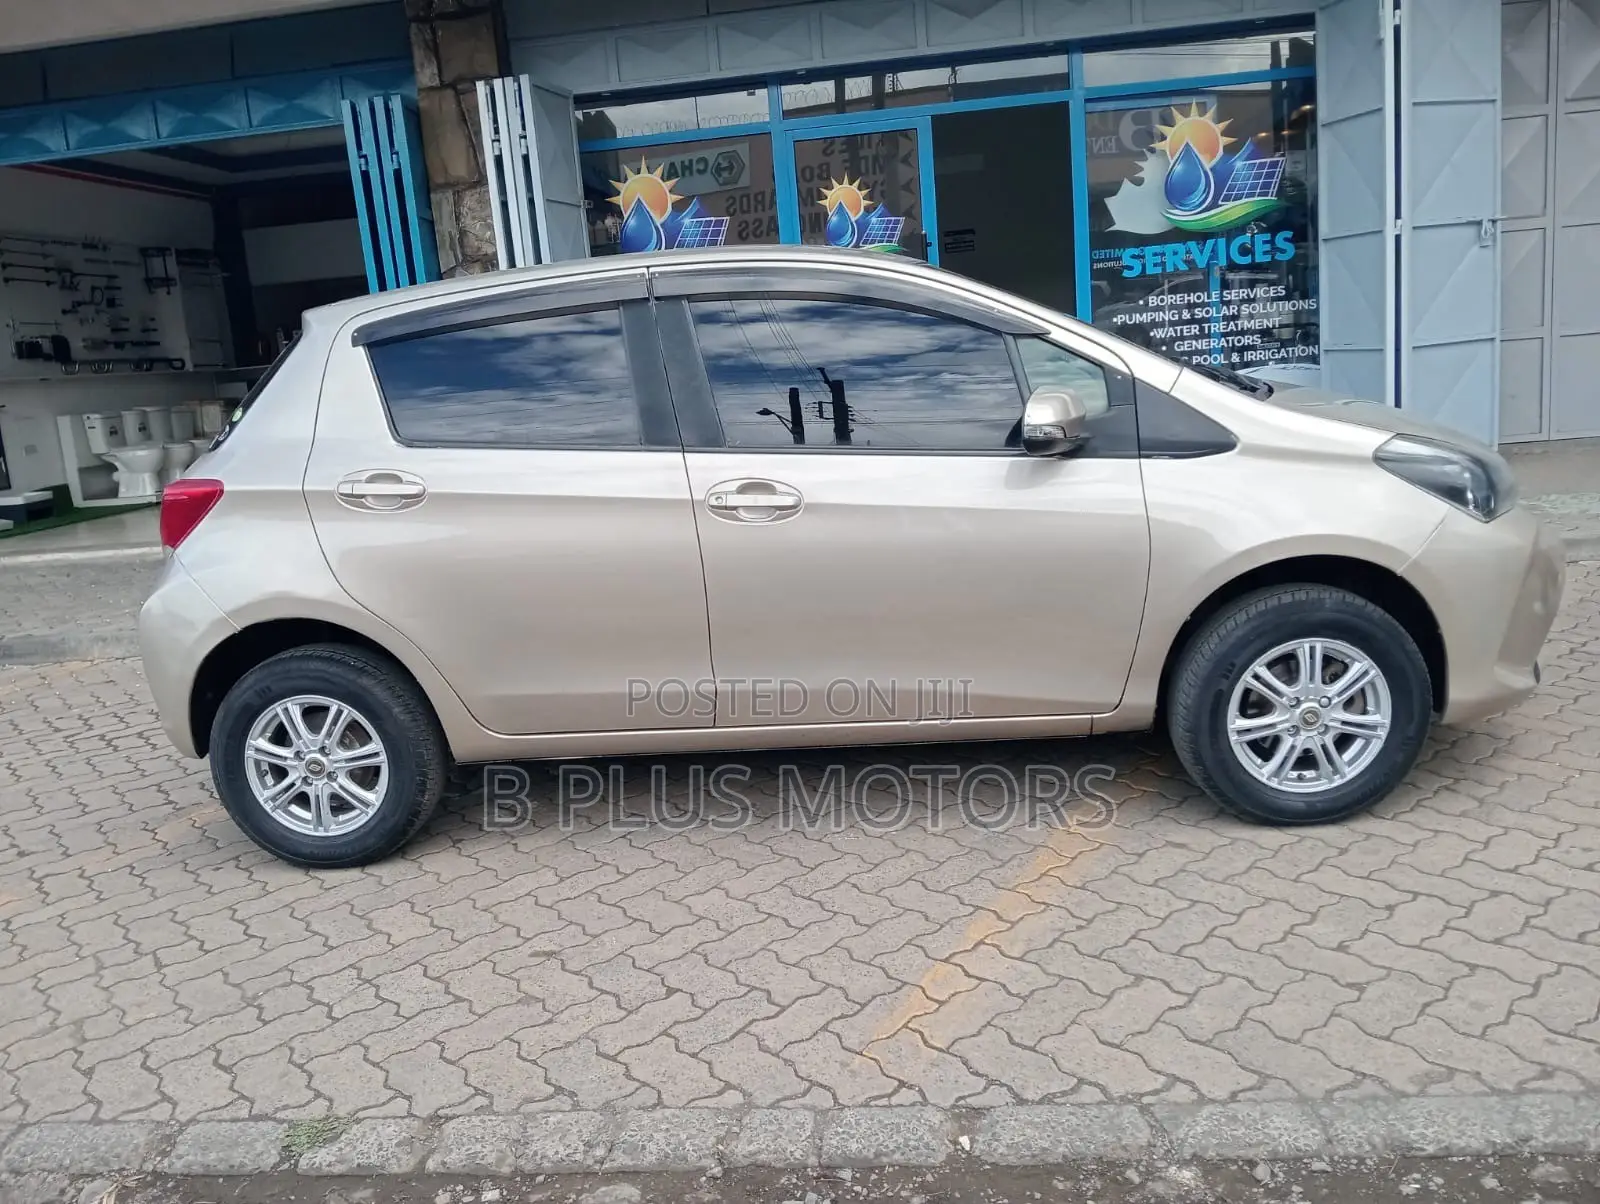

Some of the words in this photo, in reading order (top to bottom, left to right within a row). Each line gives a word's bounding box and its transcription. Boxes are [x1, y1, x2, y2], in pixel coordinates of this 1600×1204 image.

[1121, 230, 1296, 279] SERVICES
[1149, 291, 1220, 307] BOREHOLE
[1223, 285, 1286, 301] SERVICES
[1117, 310, 1179, 325] PUMPING
[1182, 308, 1192, 320] &
[1194, 304, 1238, 319] SOLAR
[1241, 299, 1317, 315] SOLUTIONS
[1154, 324, 1200, 339] WATER
[1202, 317, 1282, 335] TREATMENT
[1174, 335, 1262, 351] GENERATORS
[1192, 353, 1228, 366] POOL
[1231, 351, 1241, 363] &
[1244, 345, 1319, 361] IRRIGATION
